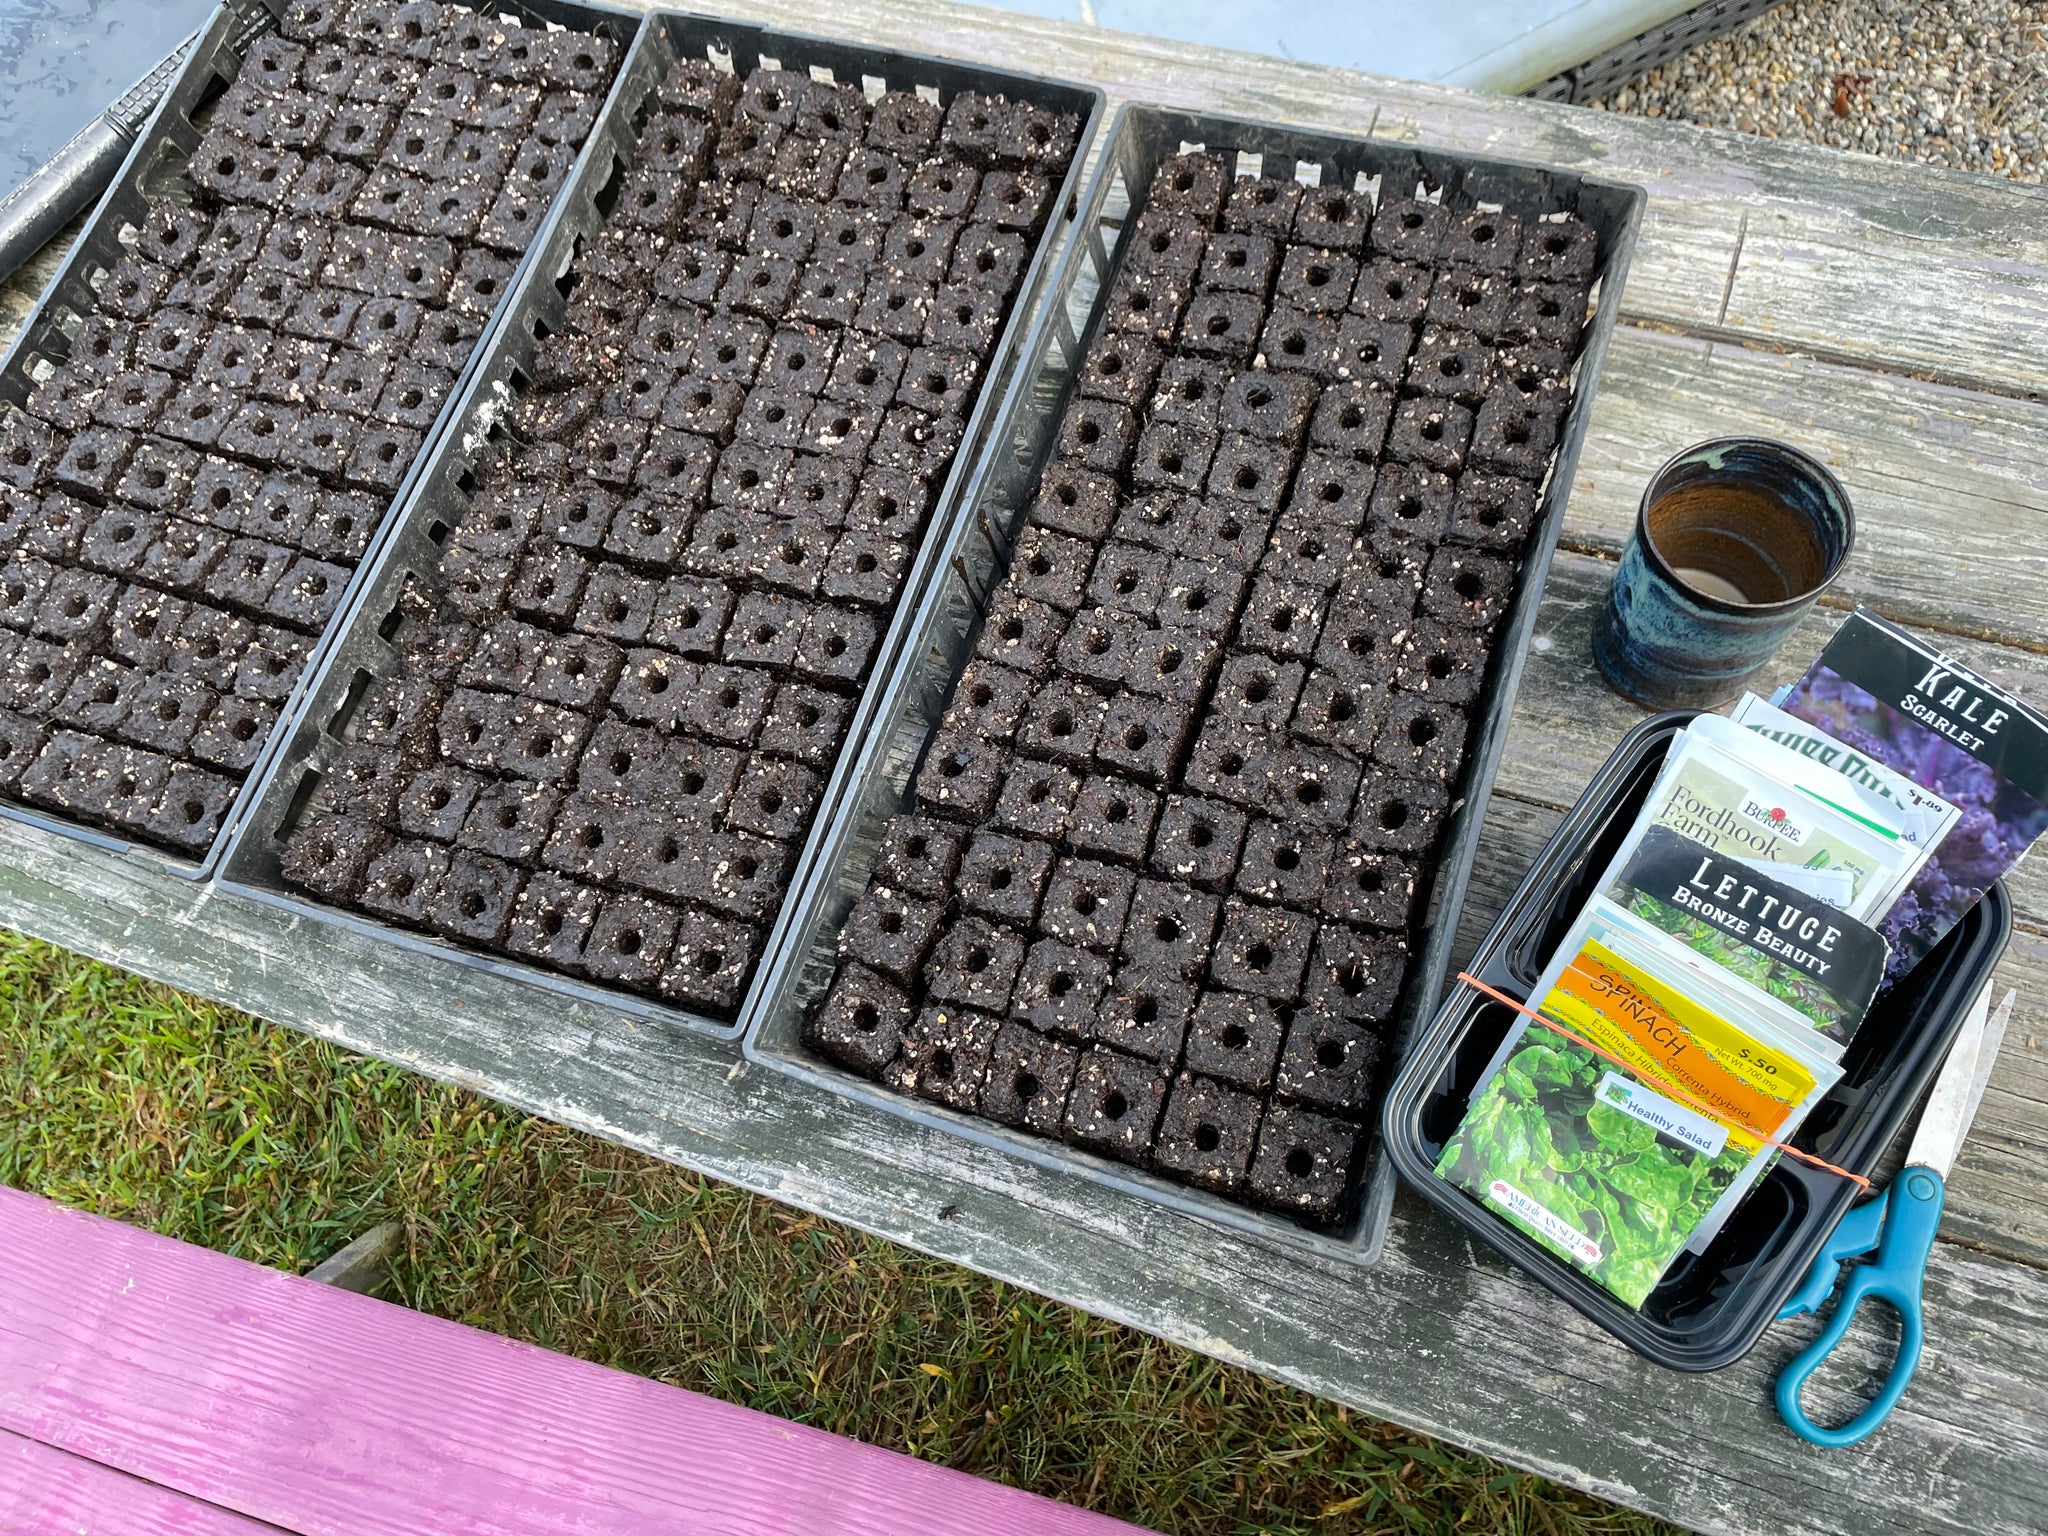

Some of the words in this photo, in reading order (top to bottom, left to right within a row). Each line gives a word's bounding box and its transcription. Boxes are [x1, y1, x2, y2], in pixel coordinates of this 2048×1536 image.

[1900, 694, 1985, 751] SCARLET
[1914, 663, 2009, 734] KALE
[1671, 785, 1783, 861] Fordhook
[1671, 885, 1751, 935] BRONZE
[1753, 925, 1832, 975] BEAUTY
[1689, 856, 1842, 953] LETTUCE
[1591, 1018, 1636, 1058] Espinaca
[1738, 1048, 1778, 1075] $.50
[1666, 1057, 1710, 1095] Correnta
[1710, 1092, 1752, 1119] Hybrid
[1714, 1047, 1729, 1061] Net
[1731, 1056, 1744, 1070] Wt.
[1746, 1067, 1763, 1080] 700
[1762, 1078, 1778, 1091] mg
[1627, 1100, 1674, 1131] Healthy
[1676, 1125, 1713, 1150] Salad
